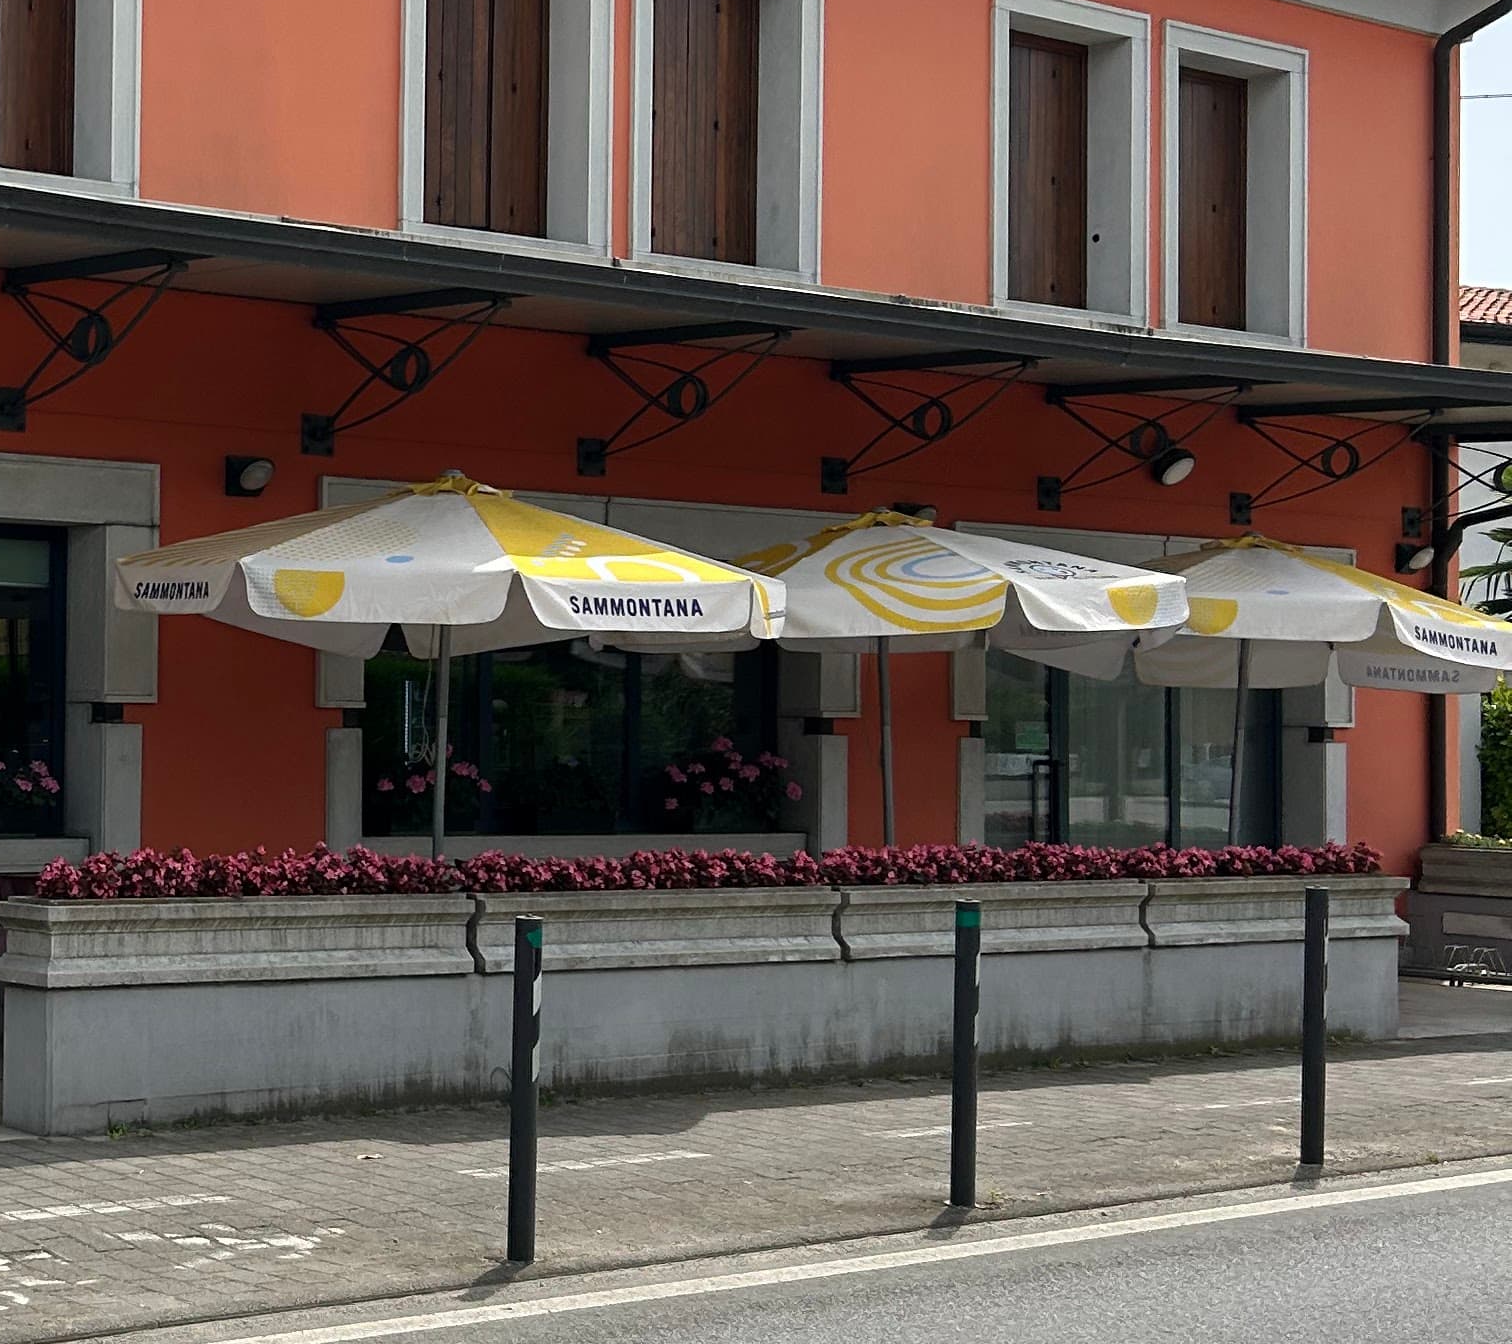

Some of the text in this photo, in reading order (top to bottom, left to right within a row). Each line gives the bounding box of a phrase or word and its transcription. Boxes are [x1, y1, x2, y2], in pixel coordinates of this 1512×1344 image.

[134, 581, 209, 600] SAMMONTANA
[569, 595, 704, 617] SAMMONTANA
[1414, 625, 1498, 656] SAMMONTANA
